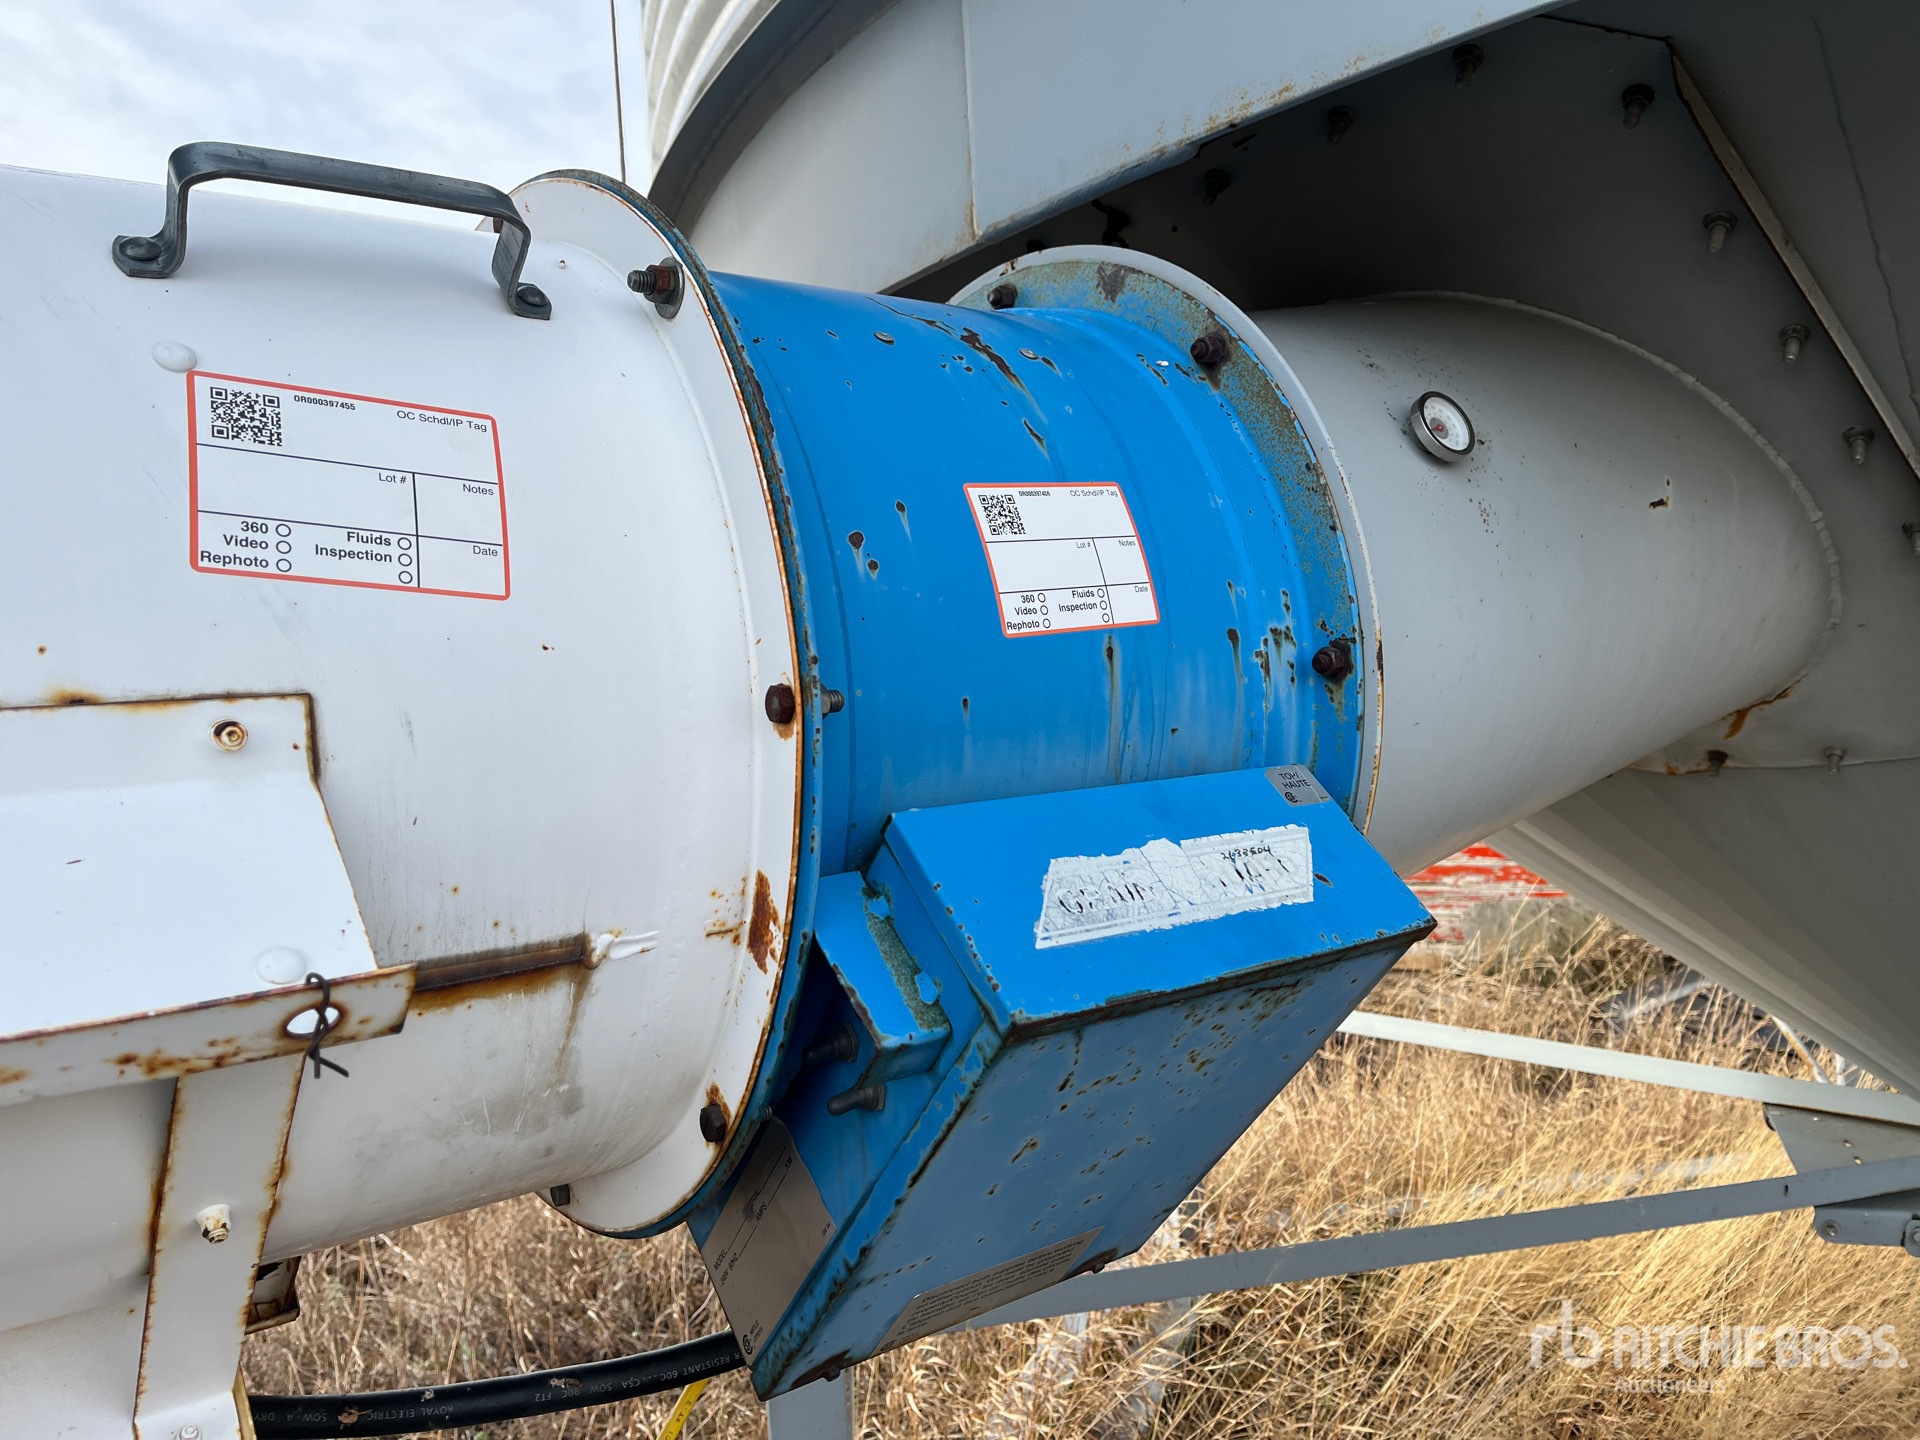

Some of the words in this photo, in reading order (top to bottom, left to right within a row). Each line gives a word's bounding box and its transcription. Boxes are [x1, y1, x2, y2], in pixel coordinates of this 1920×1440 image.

[396, 410, 416, 421] OC
[418, 413, 463, 428] Schdl/IP
[466, 421, 488, 433] Tag
[378, 472, 397, 484] Lot
[400, 476, 407, 484] #
[462, 483, 494, 496] Notes
[1105, 489, 1118, 497] Tag
[240, 521, 269, 534] 360
[222, 534, 269, 550] Video
[347, 532, 392, 547] Fluids
[1077, 541, 1086, 549] Lot
[1119, 539, 1136, 547] Notes
[315, 544, 393, 563] Inspection
[472, 545, 498, 557] Date
[200, 550, 269, 570] Rephoto
[1072, 590, 1095, 599] Fluids
[1134, 585, 1148, 593] Date
[1021, 595, 1035, 604] 360
[1014, 607, 1038, 616] Video
[1058, 602, 1097, 613] Inspection
[1006, 620, 1040, 632] Rephoto
[1282, 780, 1311, 789] HAUTE
[682, 1355, 730, 1376] RESISTANT
[534, 1392, 552, 1402] FT2
[367, 1408, 415, 1421] ELECTRIC
[421, 1405, 454, 1416] ROYAL
